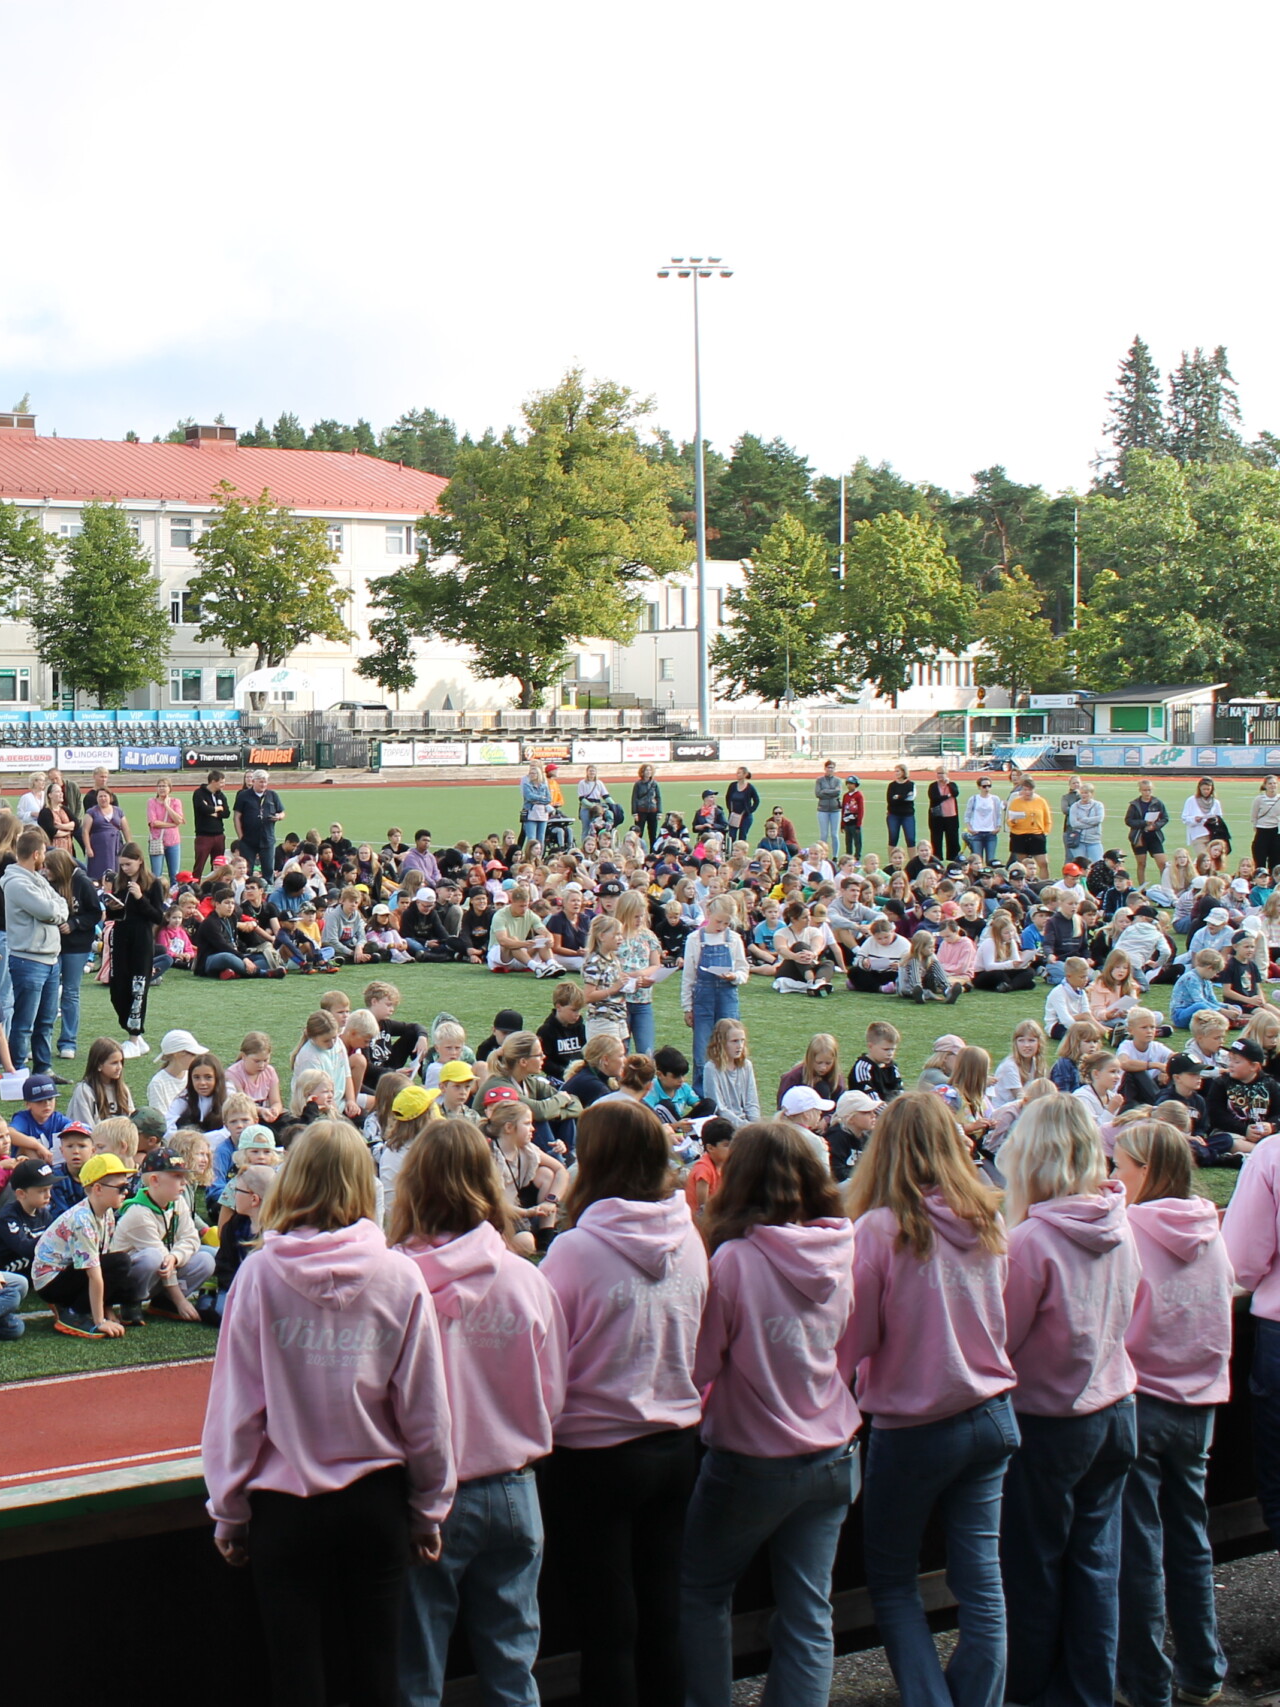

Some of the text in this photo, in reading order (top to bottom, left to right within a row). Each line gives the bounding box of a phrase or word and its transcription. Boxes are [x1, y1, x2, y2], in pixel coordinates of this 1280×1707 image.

[130, 711, 143, 719] VIP
[213, 711, 226, 719] VIP
[1230, 706, 1260, 717] KAHU
[44, 712, 57, 720] VIP
[74, 750, 113, 758] LINDGREN
[677, 746, 705, 756] CRAFT
[199, 753, 238, 762] Thermotech
[249, 747, 293, 765] Faluplast
